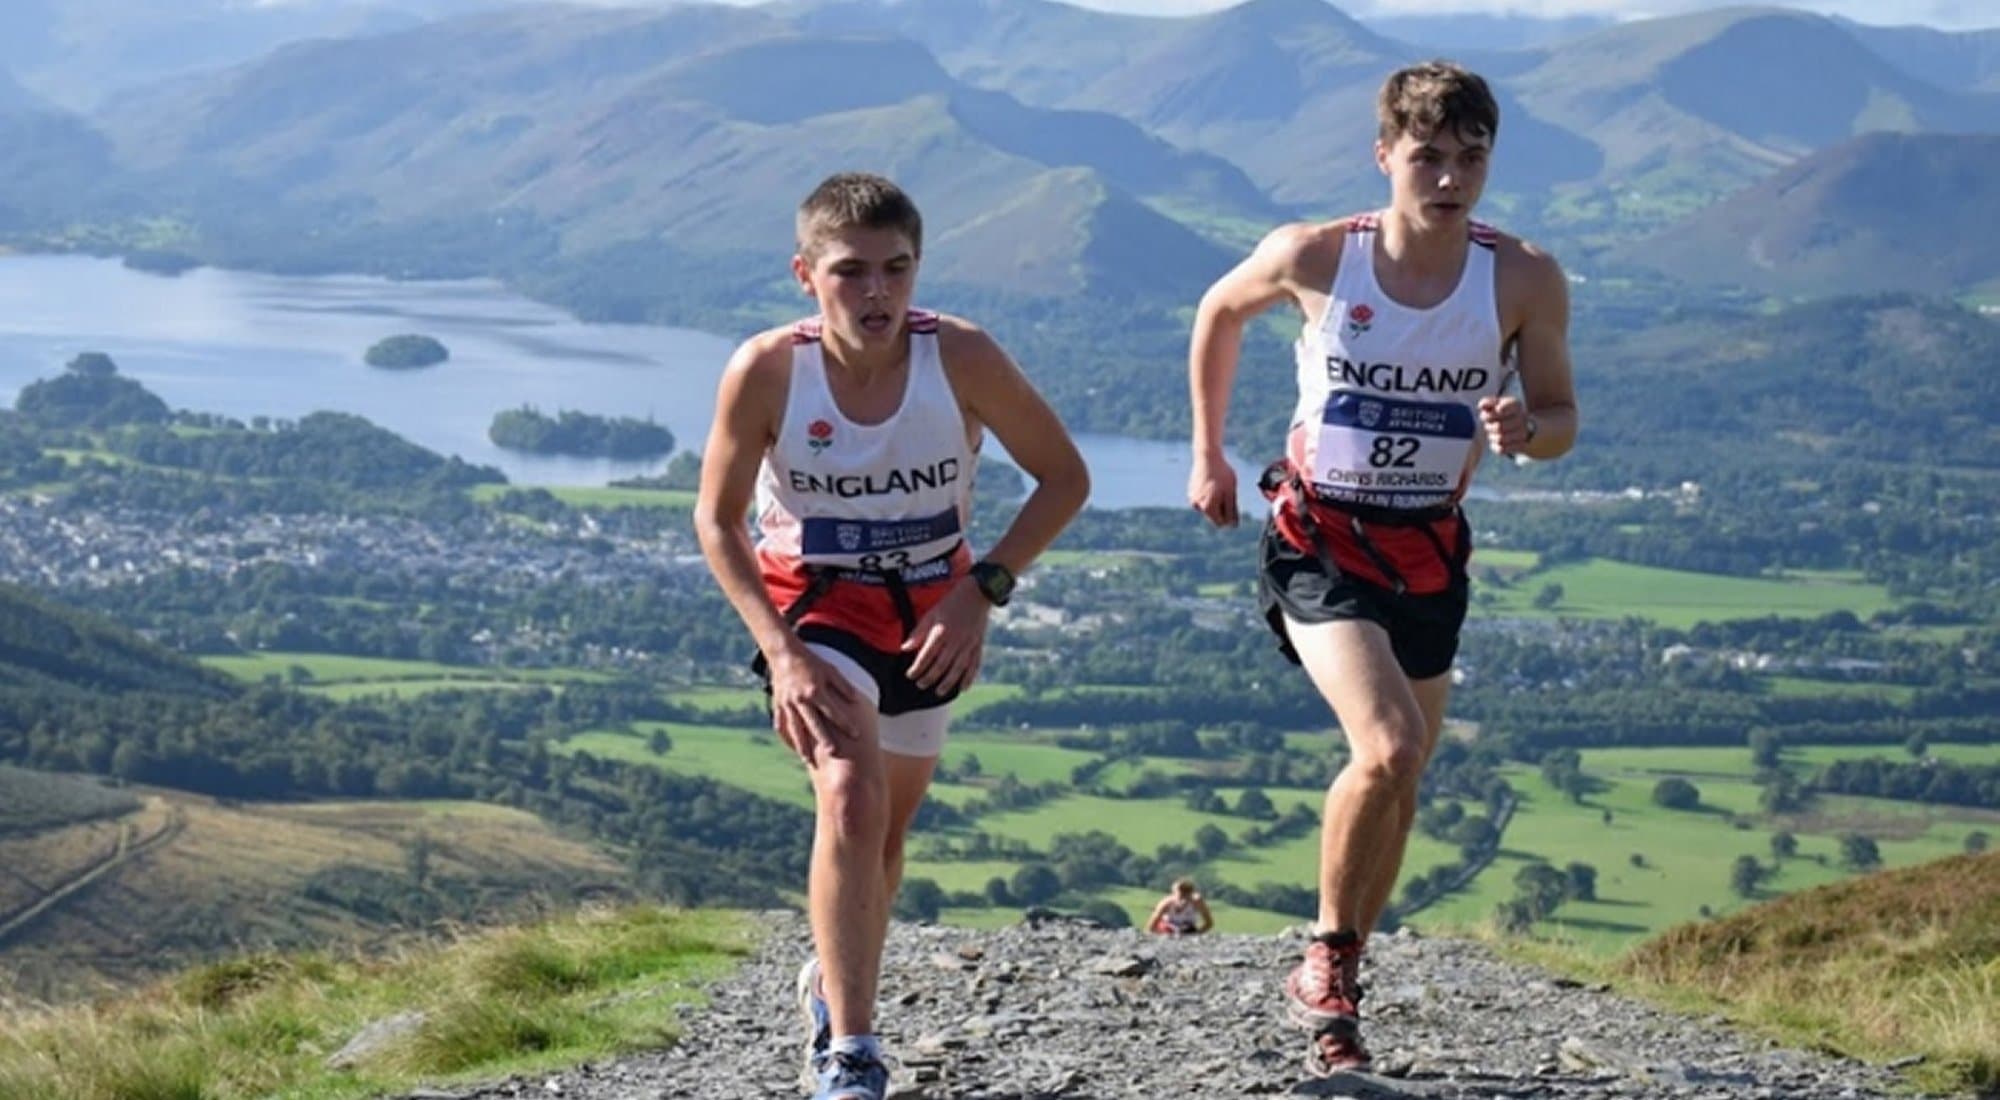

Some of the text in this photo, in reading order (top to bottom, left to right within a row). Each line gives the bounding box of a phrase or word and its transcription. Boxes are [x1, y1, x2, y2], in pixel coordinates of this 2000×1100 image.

[1327, 357, 1488, 392] ENGLAND
[1369, 436, 1420, 468] 82
[789, 458, 958, 497] ENGLAND
[1328, 468, 1449, 486] CHRIS RICHARDS
